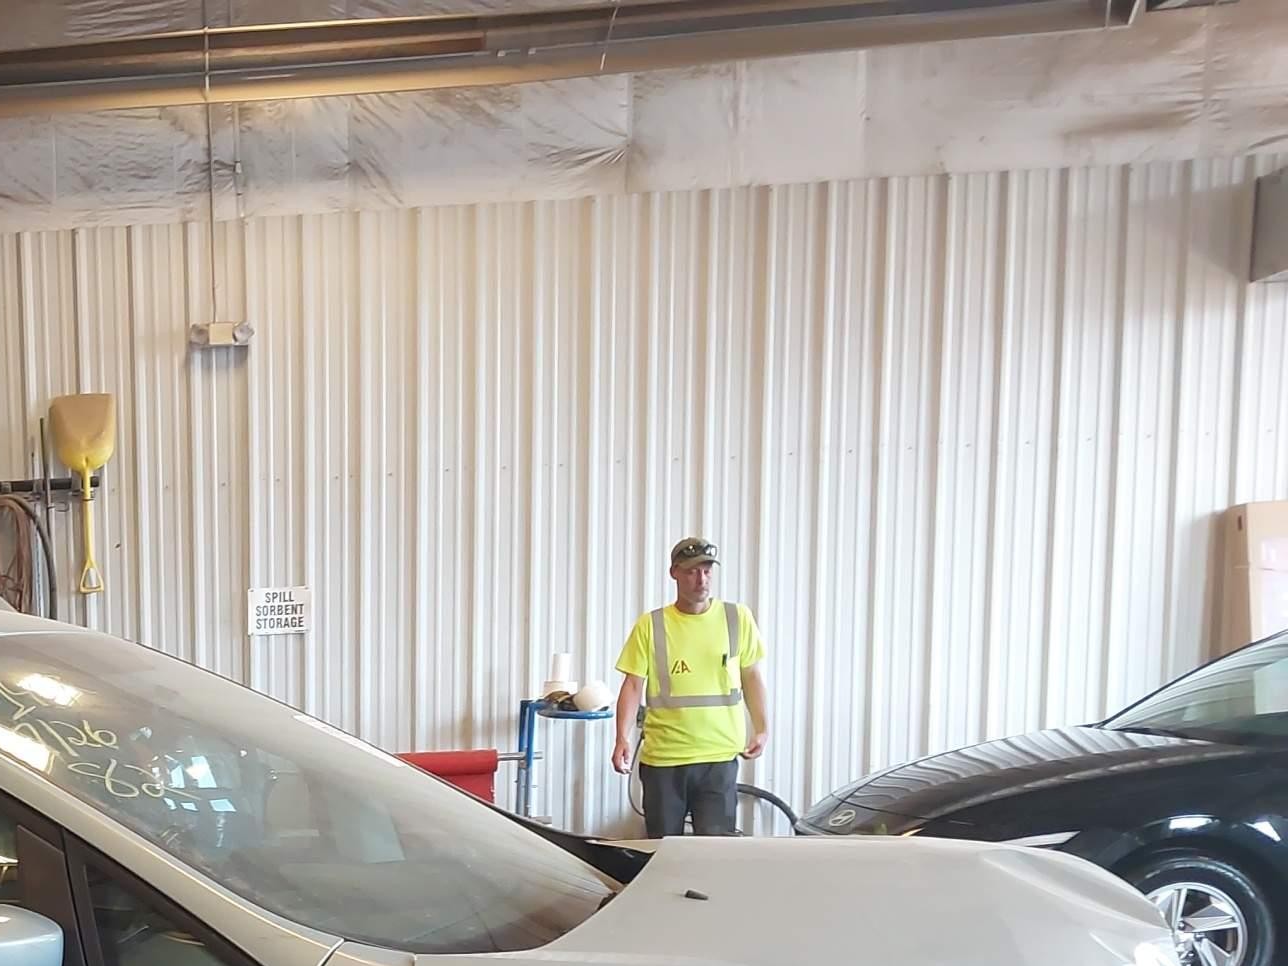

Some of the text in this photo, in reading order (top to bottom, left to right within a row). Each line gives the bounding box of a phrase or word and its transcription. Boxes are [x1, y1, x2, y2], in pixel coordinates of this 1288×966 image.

[265, 591, 295, 603] SPILL
[255, 603, 305, 617] SORBENT
[255, 616, 305, 630] STORAGE
